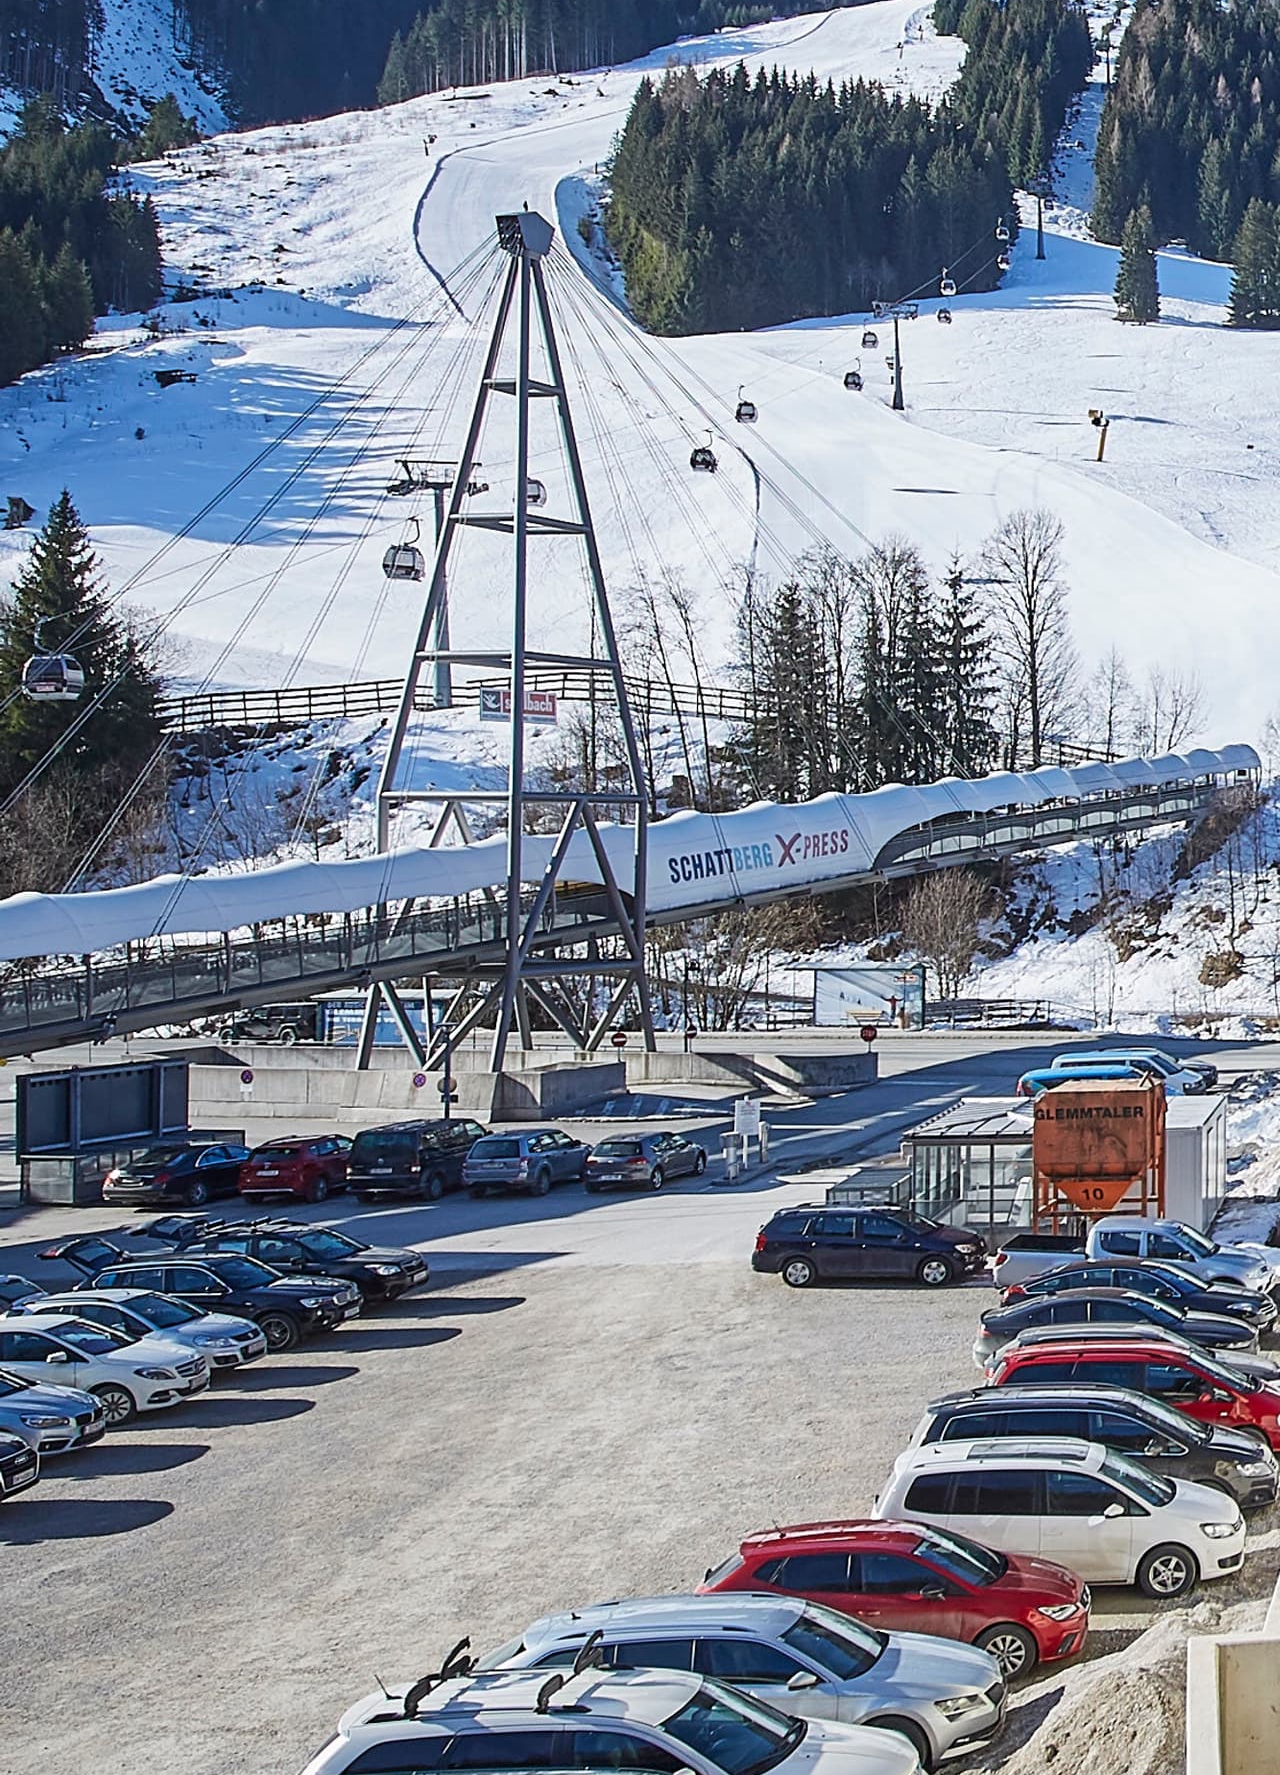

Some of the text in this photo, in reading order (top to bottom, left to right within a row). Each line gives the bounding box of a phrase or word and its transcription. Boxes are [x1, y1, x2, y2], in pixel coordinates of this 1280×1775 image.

[504, 693, 553, 713] slbach
[668, 829, 849, 884] SCHATTBERG X-PRESS
[1035, 1105, 1144, 1121] GLEMMTALER
[1082, 1187, 1104, 1201] 10
